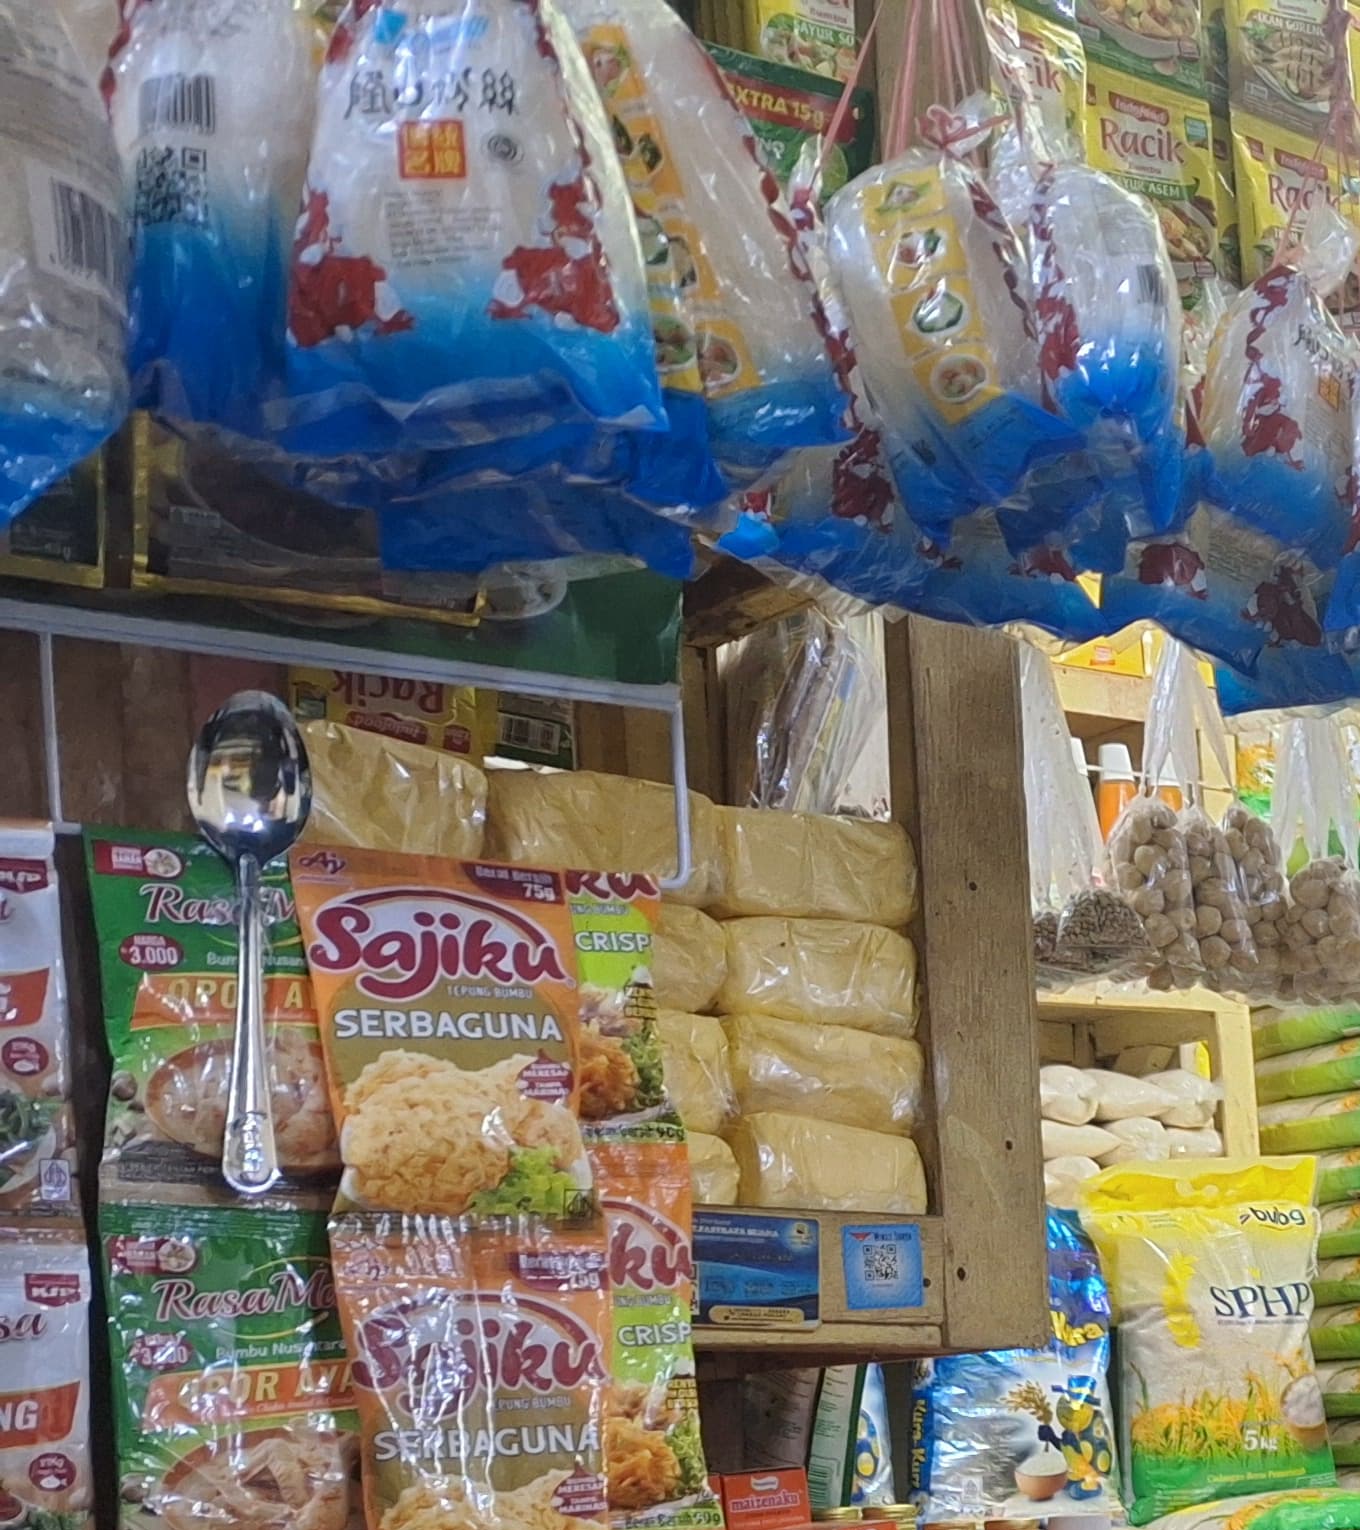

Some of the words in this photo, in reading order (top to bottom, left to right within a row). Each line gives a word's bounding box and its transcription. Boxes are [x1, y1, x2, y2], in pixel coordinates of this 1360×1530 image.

[791, 101, 825, 131] 15g
[1100, 117, 1185, 164] Racik
[523, 883, 556, 901] 75g
[129, 946, 178, 966] 3.000
[309, 905, 571, 1002] Sajiku
[168, 977, 238, 1009] OPO
[447, 984, 490, 997] TEPUNG
[493, 986, 534, 999] BUMBU
[333, 1009, 564, 1042] SERBAGUNA
[152, 1267, 339, 1323] RasaMa
[1209, 1282, 1310, 1320] SPHP
[351, 1317, 608, 1418] Sajiku
[373, 1423, 601, 1462] SERBAGUNA
[1243, 1428, 1258, 1451] 5
[730, 1491, 801, 1512] maizenaku
